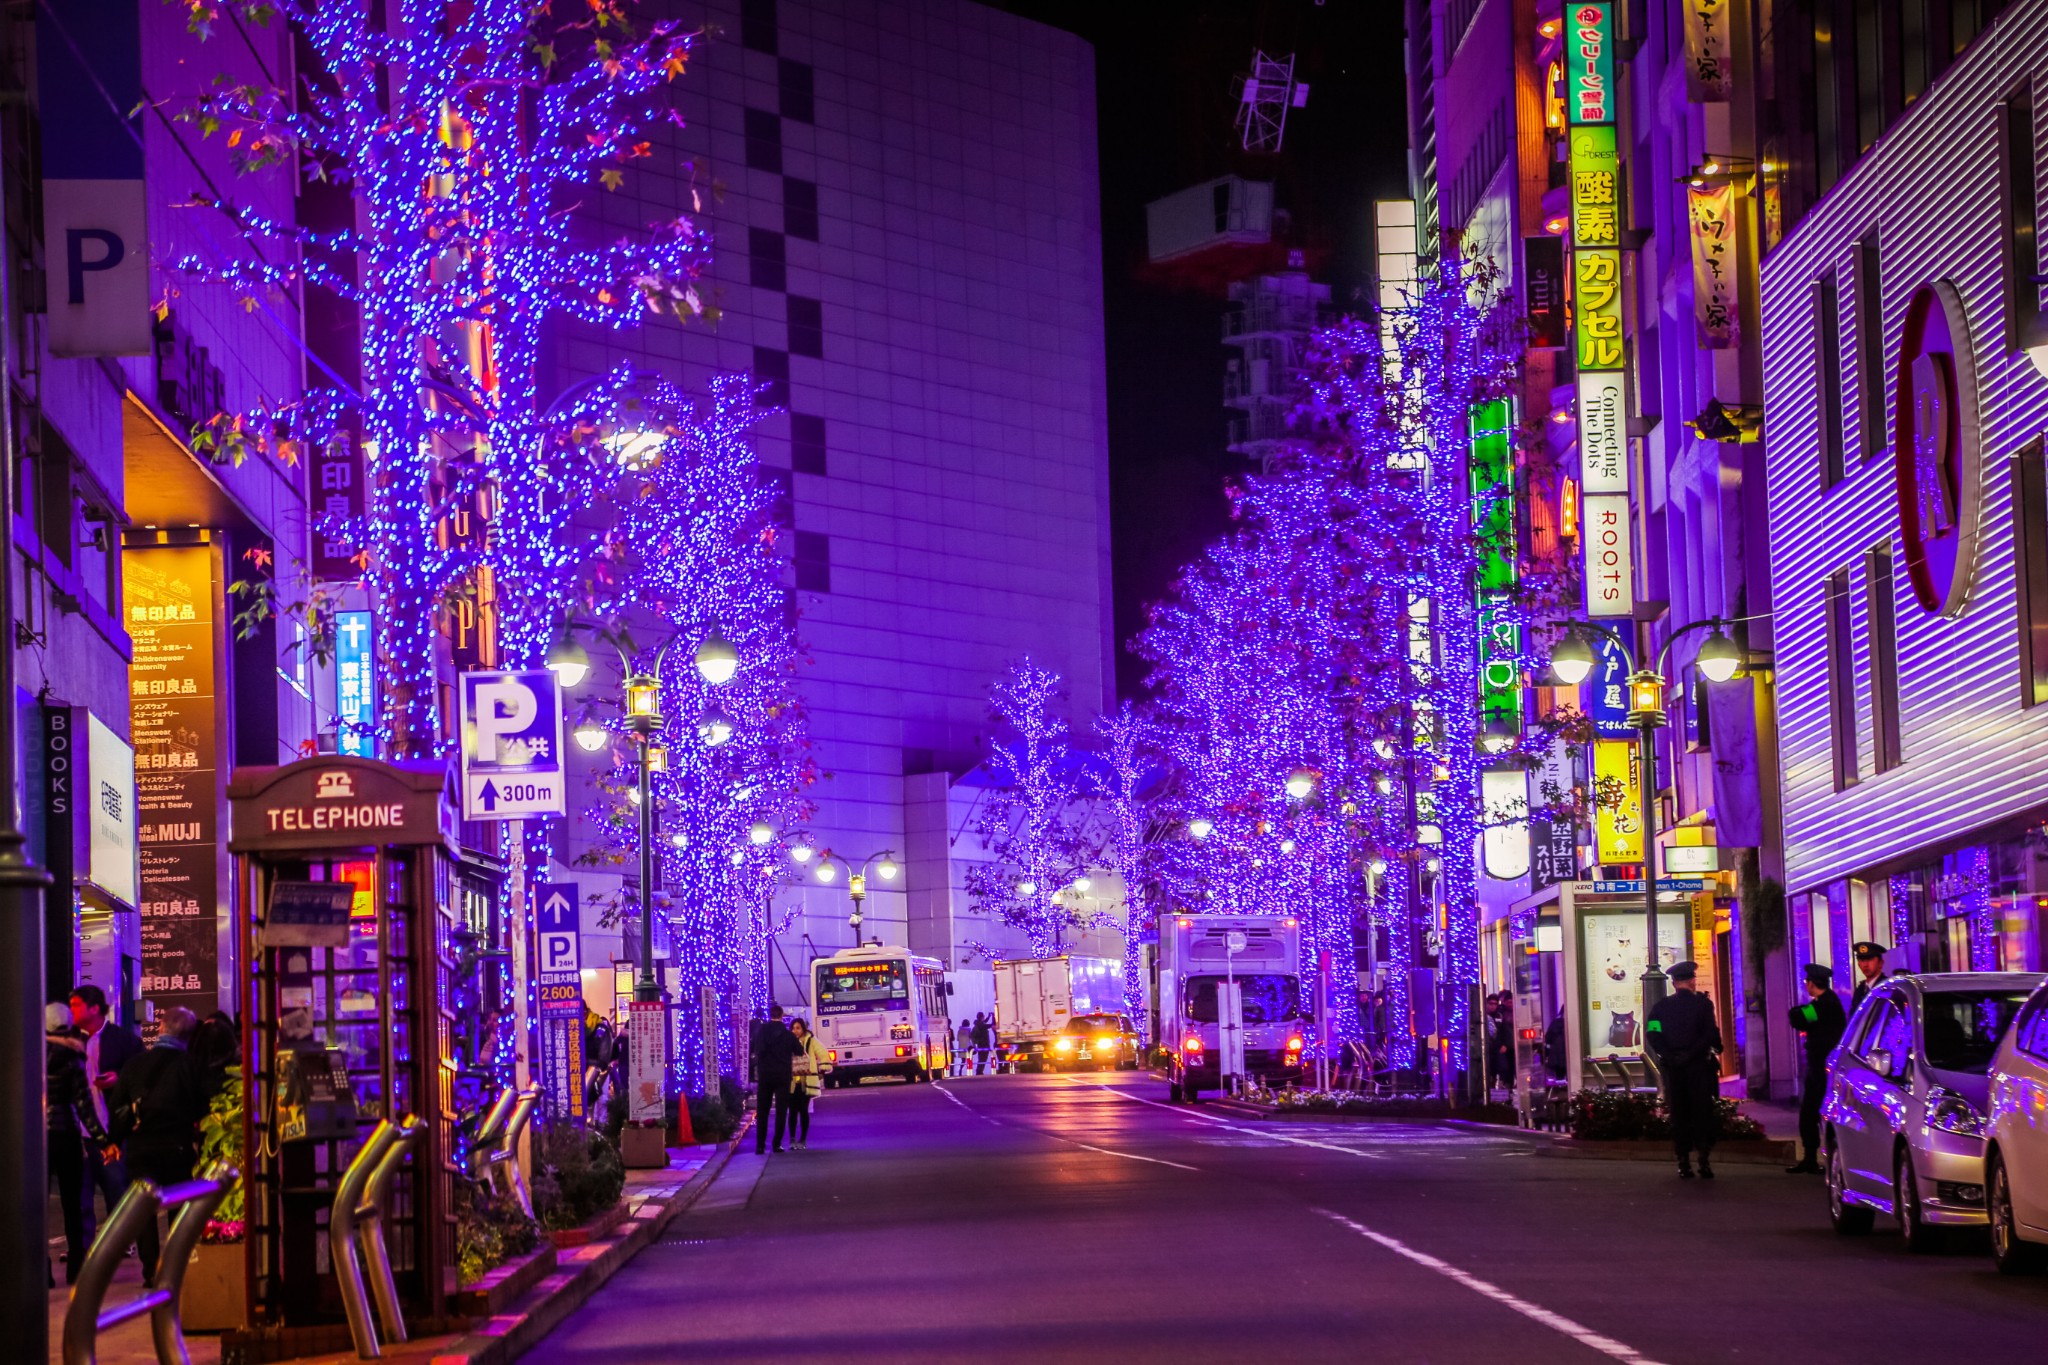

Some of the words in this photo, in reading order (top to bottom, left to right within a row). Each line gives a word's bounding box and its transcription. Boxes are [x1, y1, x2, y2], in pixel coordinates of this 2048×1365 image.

[1575, 171, 1614, 242] 酸素
[66, 229, 124, 304] P
[1531, 268, 1549, 316] little
[1579, 253, 1620, 367] カプセル
[1586, 395, 1602, 428] The
[1601, 385, 1621, 478] Connecting
[1587, 432, 1602, 469] Dots
[1602, 510, 1621, 601] ROOTS
[131, 605, 196, 622] 無印良品
[132, 655, 185, 664] Childrenswear
[132, 678, 197, 695] 無印良品
[475, 684, 537, 762] P
[134, 737, 172, 745] Stationery
[505, 737, 549, 759] 公共
[50, 715, 67, 814] BOOKS
[134, 752, 199, 769] 無印良品
[503, 785, 552, 801] 300m
[168, 802, 193, 810] Beauty
[267, 804, 404, 831] TELEPHONE
[158, 823, 201, 841] MUJI
[143, 875, 190, 883] Delicatessen
[1596, 881, 1647, 892] 神南一丁目
[1672, 881, 1702, 889] 1-Chome
[139, 900, 200, 917] 無印良品
[141, 943, 164, 951] icycle
[162, 950, 185, 958] goods
[549, 937, 571, 967] P
[141, 974, 202, 991] 無印良品
[823, 1005, 841, 1013] KEIO
